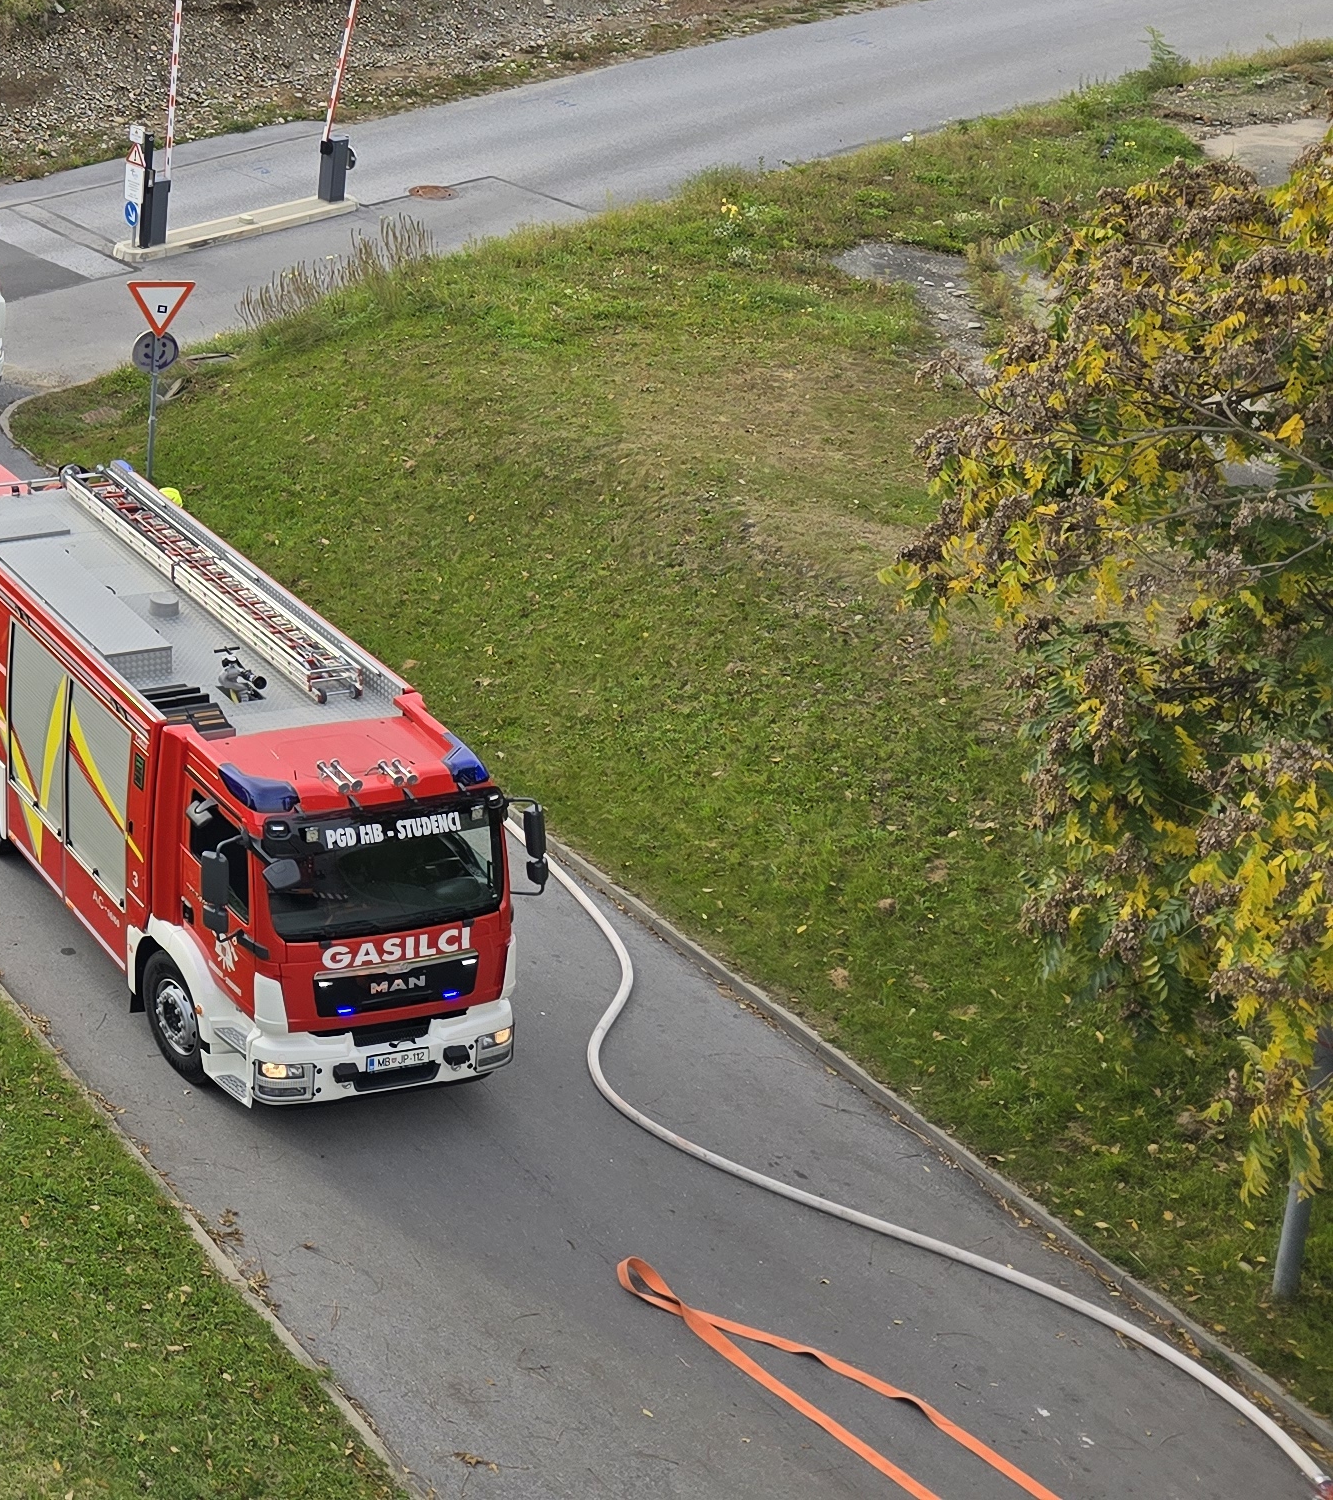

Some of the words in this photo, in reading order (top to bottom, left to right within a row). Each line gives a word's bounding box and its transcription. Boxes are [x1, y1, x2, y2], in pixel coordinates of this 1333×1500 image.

[325, 827, 357, 849] PGD
[358, 823, 384, 845] MB
[396, 811, 462, 840] STUDENCI
[132, 871, 139, 888] 3
[321, 926, 471, 970] GASILCI
[370, 975, 426, 995] MAN
[377, 1057, 391, 1067] MB
[397, 1051, 425, 1065] JP-112
